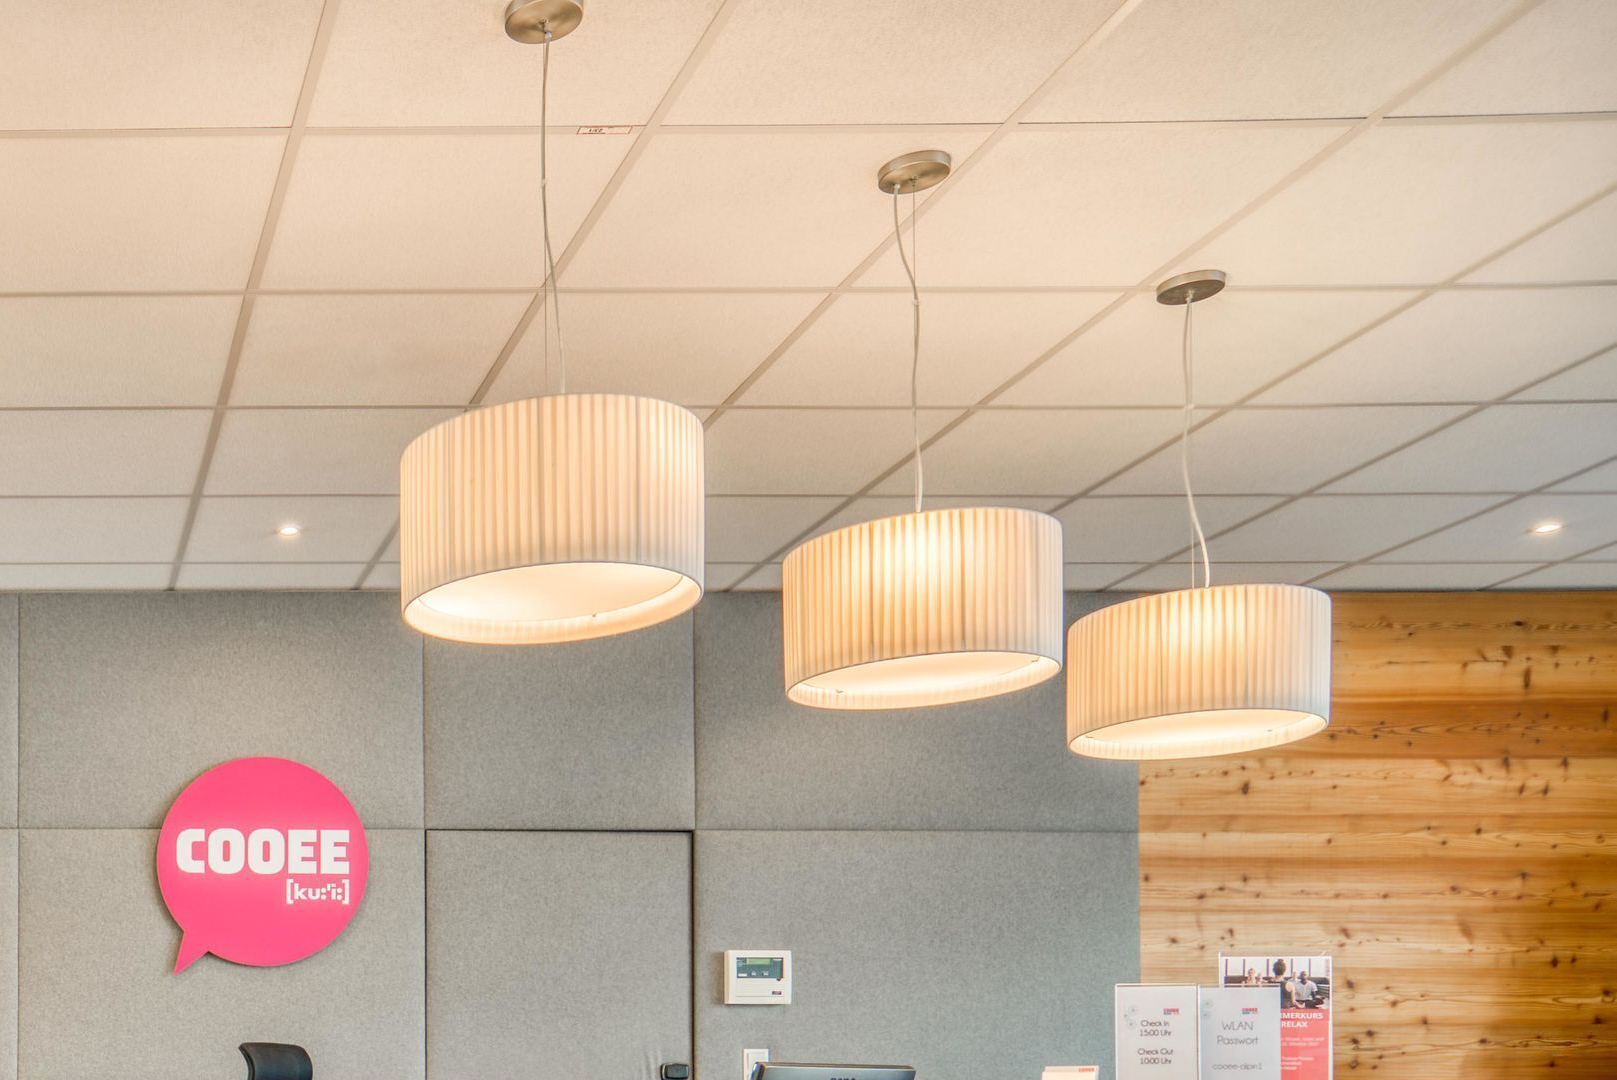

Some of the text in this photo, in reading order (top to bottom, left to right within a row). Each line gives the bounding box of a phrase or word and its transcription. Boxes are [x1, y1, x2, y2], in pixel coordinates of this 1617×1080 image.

[176, 828, 350, 874] COOEE
[1280, 1012, 1324, 1020] MERKURS
[1222, 1021, 1254, 1031] WLAN
[1160, 1029, 1172, 1037] Uhr
[1217, 1035, 1259, 1045] Passwort
[1160, 1057, 1172, 1065] Uhr
